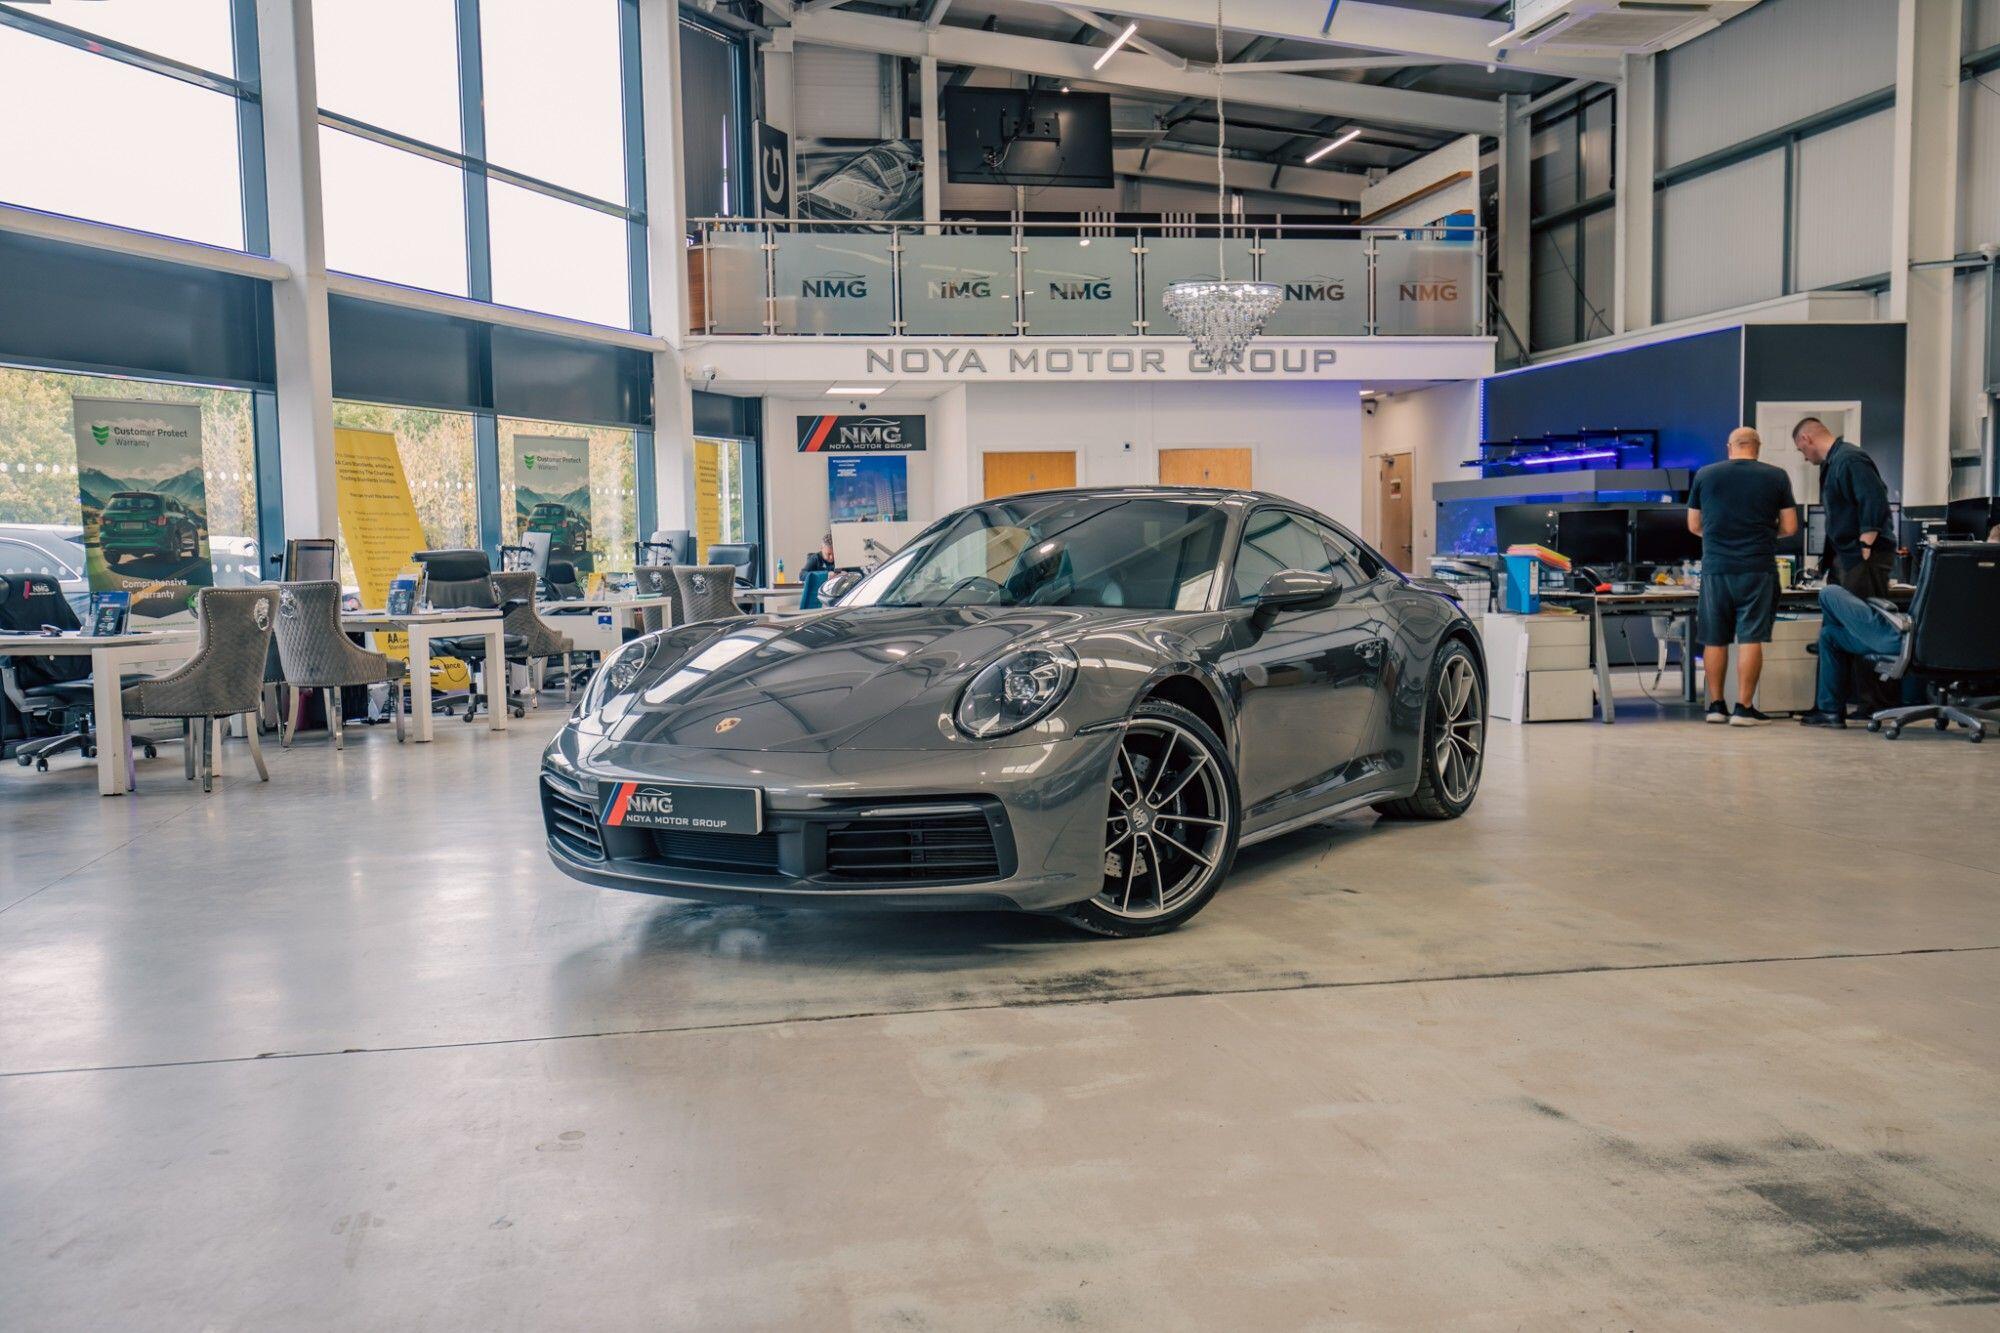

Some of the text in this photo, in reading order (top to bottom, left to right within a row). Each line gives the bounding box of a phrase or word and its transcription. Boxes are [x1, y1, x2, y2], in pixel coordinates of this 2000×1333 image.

[802, 280, 868, 298] NMG
[1049, 281, 1112, 300] NMG
[1285, 283, 1345, 301] NMG
[1399, 284, 1458, 301] NMG
[866, 348, 988, 373] NOYA
[1009, 348, 1167, 373] MOTOR
[113, 426, 188, 438] Customer Protect
[839, 426, 902, 443] NMG
[122, 577, 188, 589] Comprehensive
[387, 633, 399, 643] AA
[626, 795, 674, 813] NMG
[626, 814, 728, 828] NOYA MOTOR GROUP
